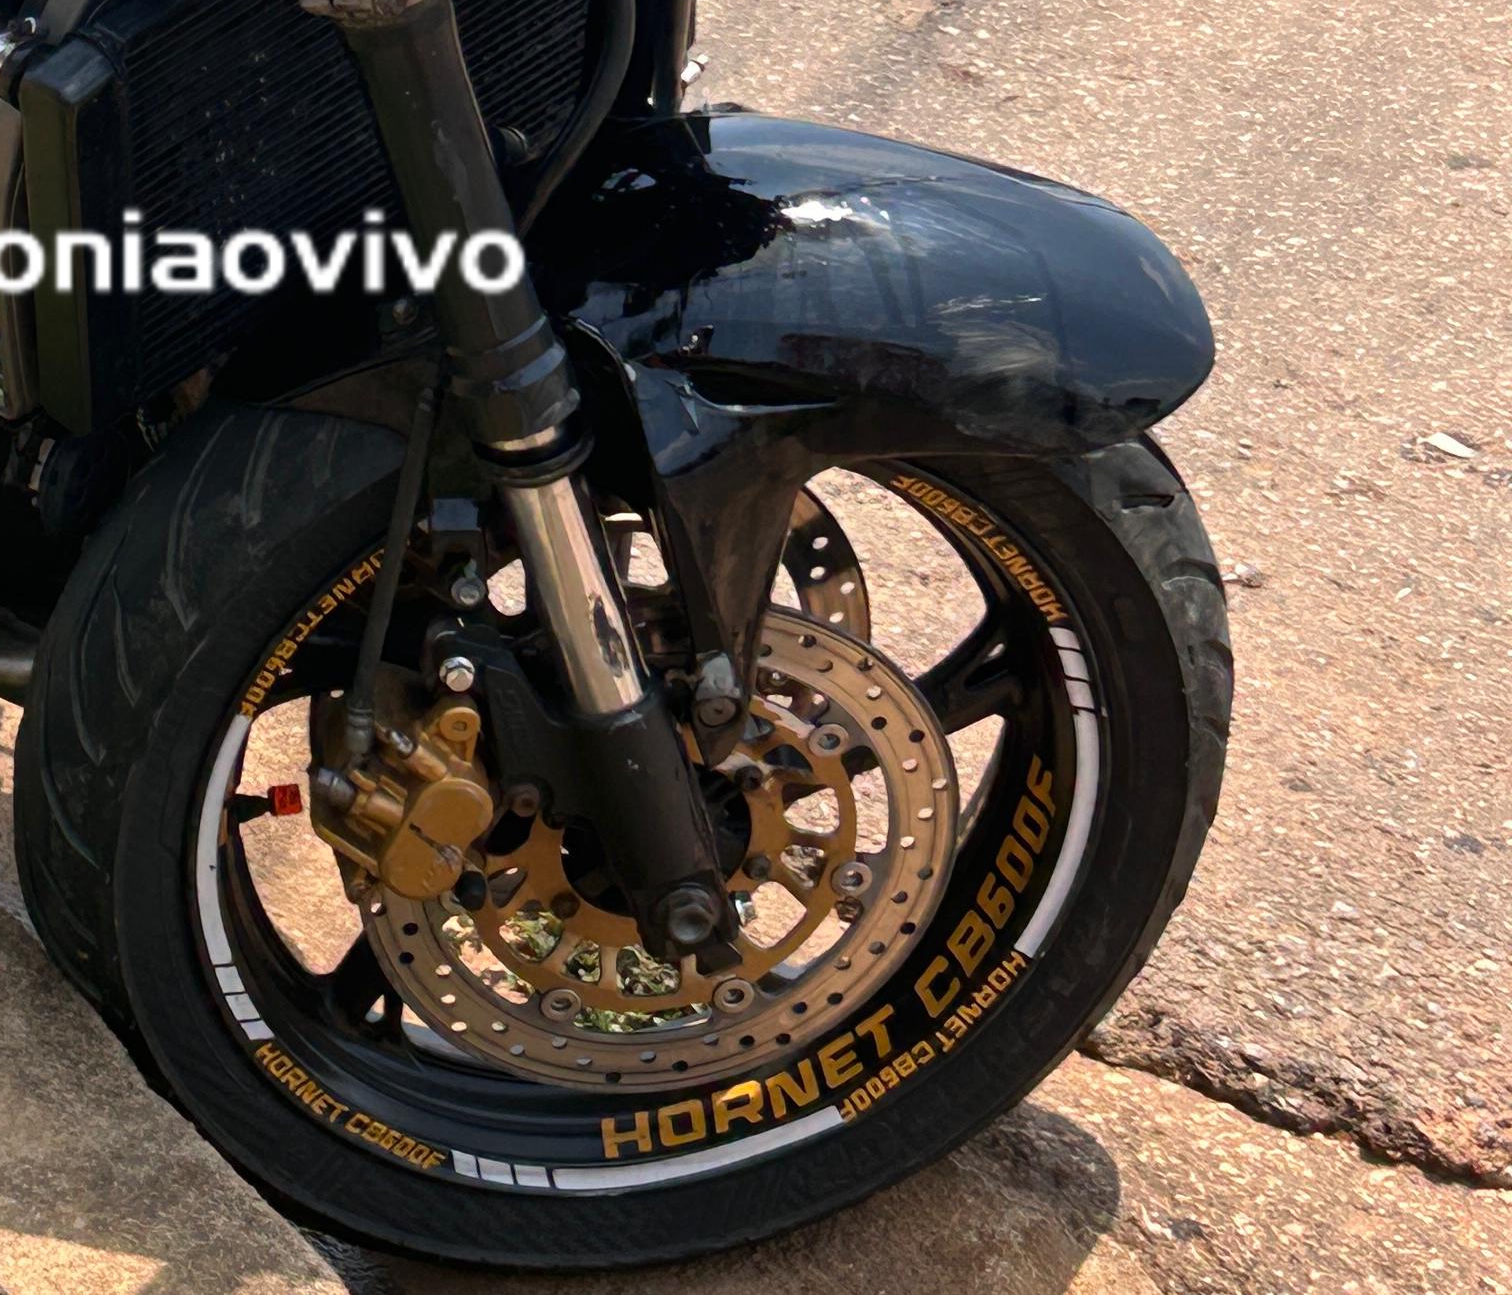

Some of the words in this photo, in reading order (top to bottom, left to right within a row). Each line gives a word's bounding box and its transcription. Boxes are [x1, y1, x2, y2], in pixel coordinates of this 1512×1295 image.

[601, 1004, 896, 1160] HORNET
[914, 754, 1058, 1018] CB600F
[934, 950, 1028, 1054] HORNET
[255, 1042, 350, 1123] HORNET
[343, 1112, 447, 1170] CB600F
[838, 1042, 935, 1124] CB600F
